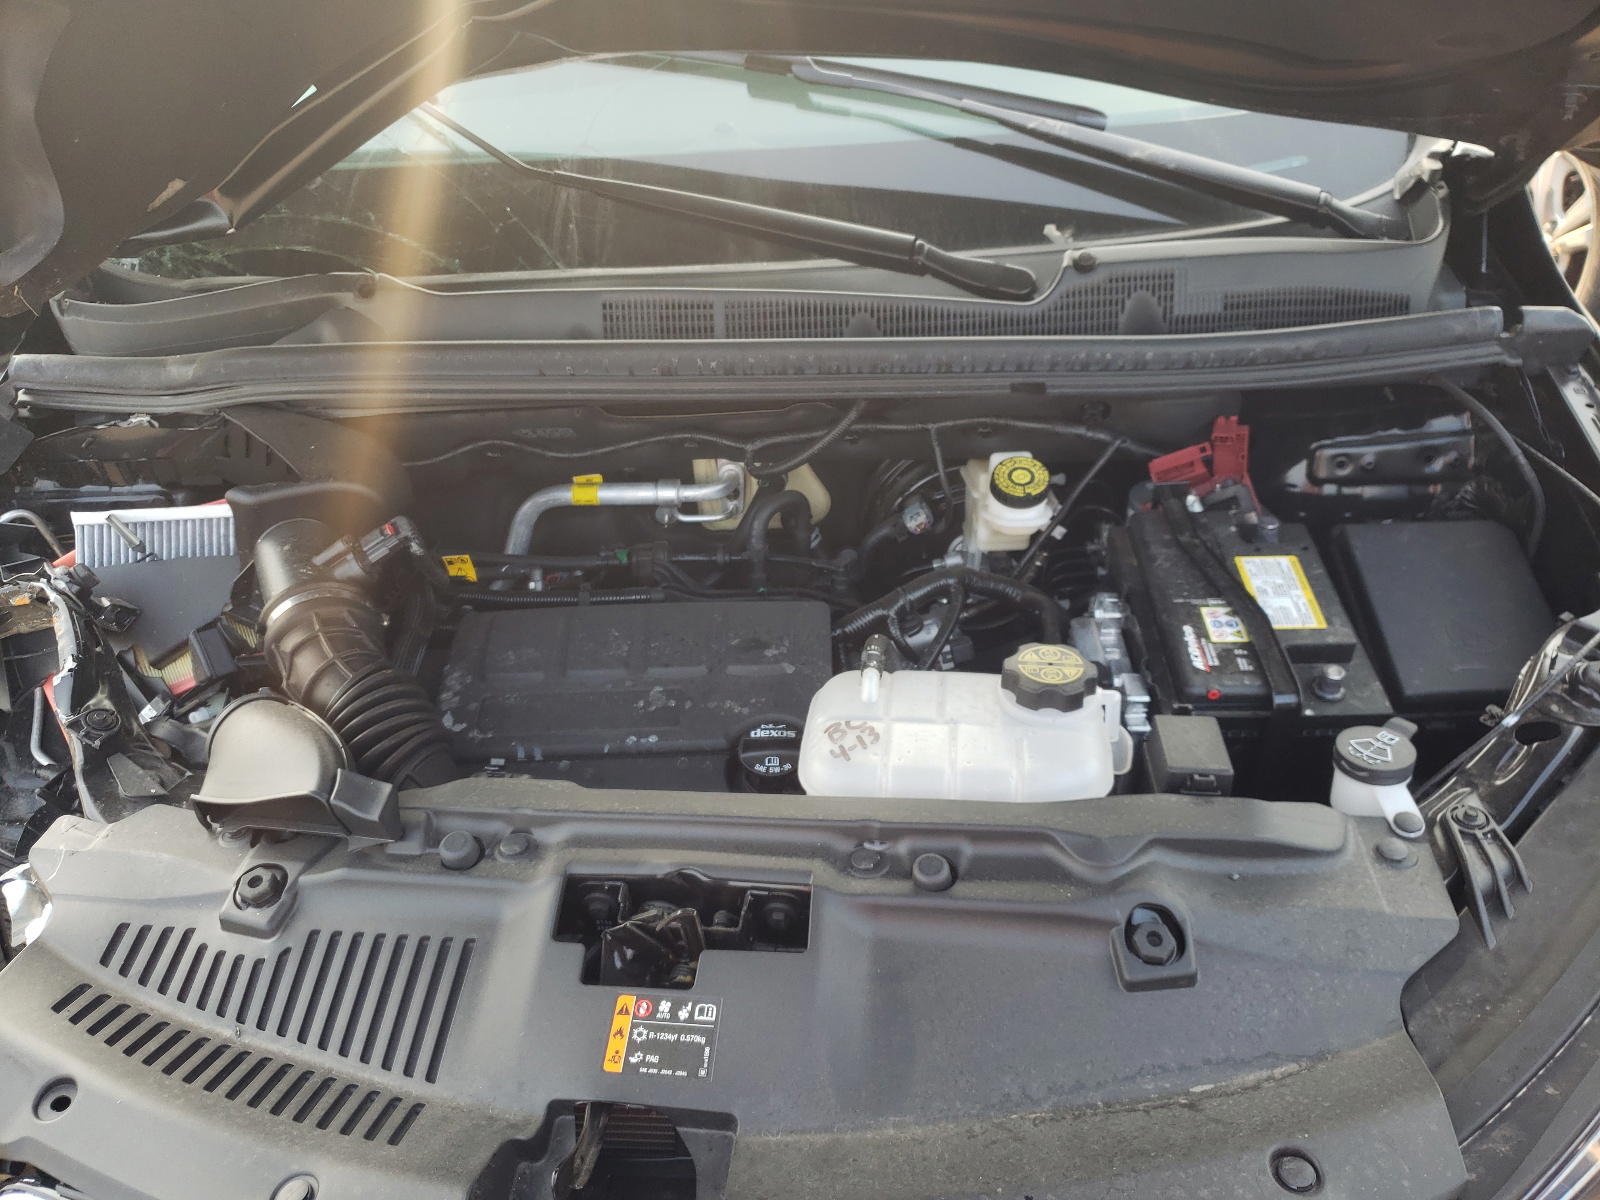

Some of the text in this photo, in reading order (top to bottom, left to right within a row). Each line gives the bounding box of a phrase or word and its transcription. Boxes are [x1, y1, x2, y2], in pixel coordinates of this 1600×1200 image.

[750, 726, 797, 738] dexos
[754, 763, 792, 773] SAE 5W-30
[648, 1031, 678, 1042] R-1234yf
[645, 1054, 660, 1063] PAG
